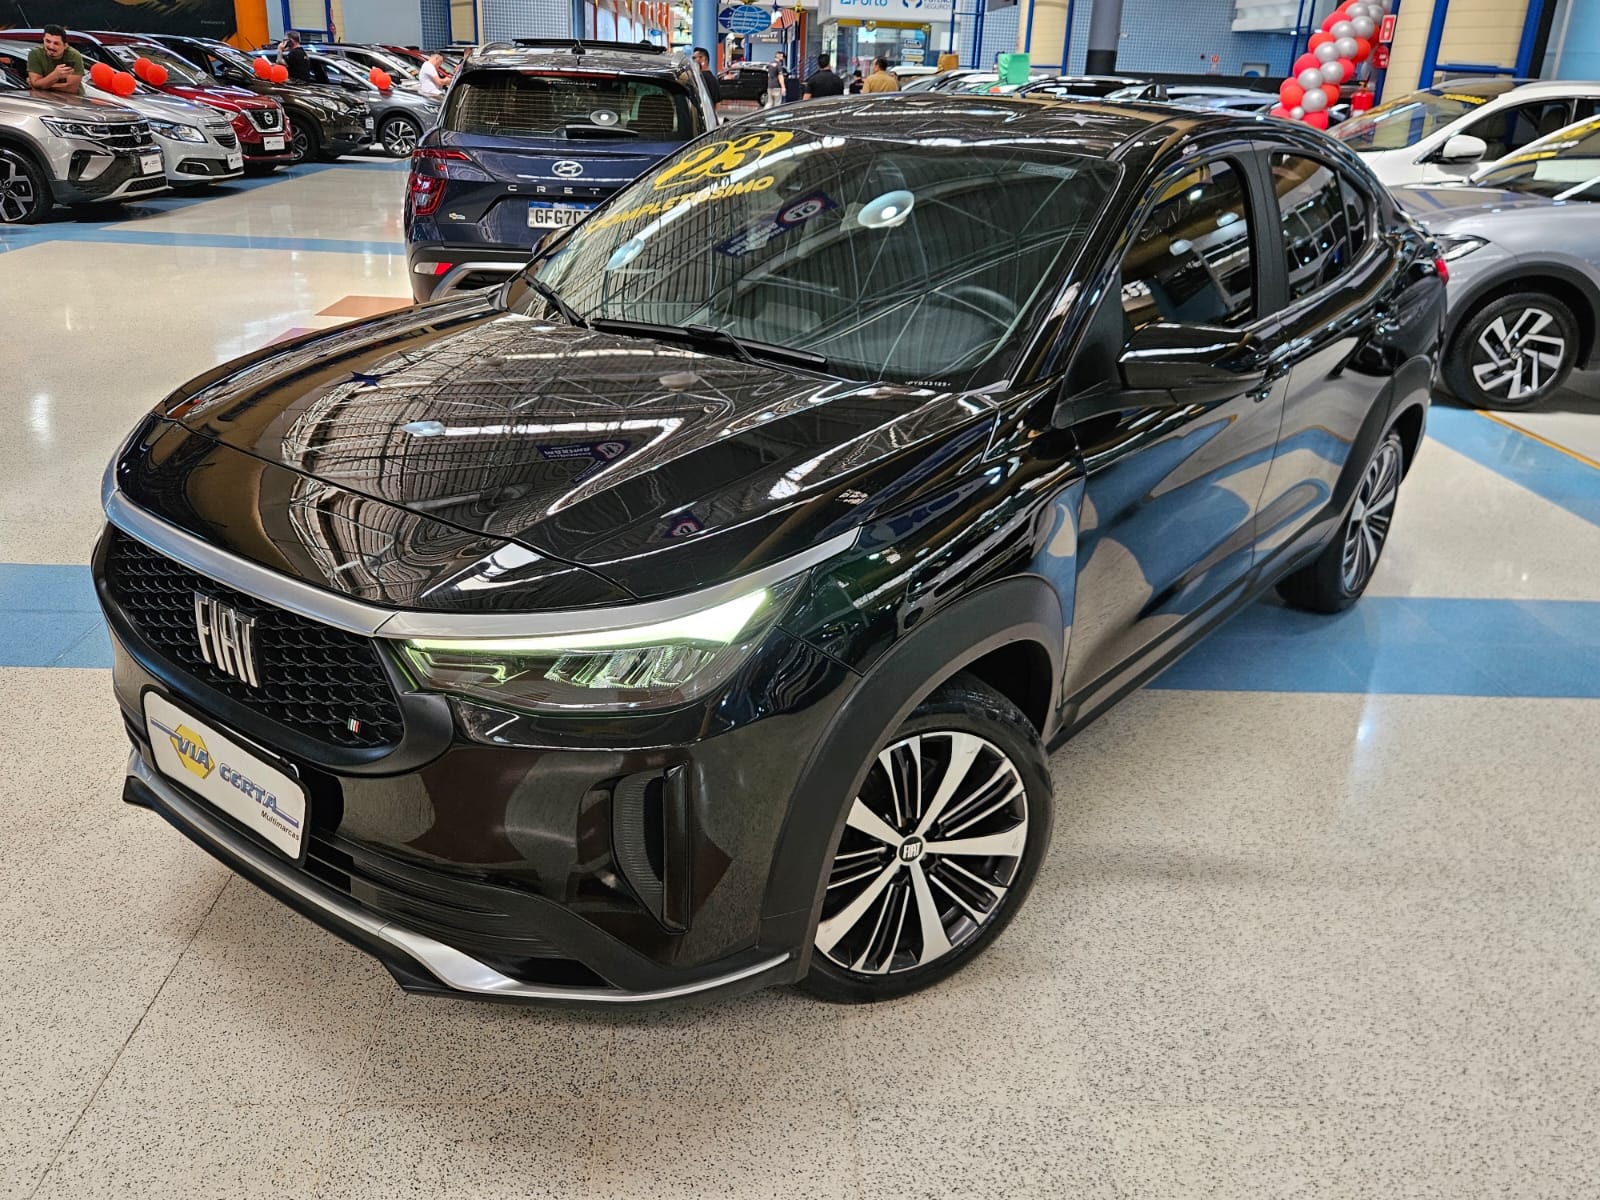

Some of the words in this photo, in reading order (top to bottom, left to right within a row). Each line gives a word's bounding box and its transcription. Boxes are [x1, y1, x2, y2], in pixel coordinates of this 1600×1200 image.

[654, 131, 794, 190] 23
[507, 184, 600, 195] CRET
[535, 209, 589, 224] GFG7C
[194, 591, 259, 688] FIAT
[177, 735, 210, 770] VIA
[219, 762, 278, 811] CERTA
[261, 810, 300, 841] Multimarcas
[902, 842, 921, 859] FIAT
